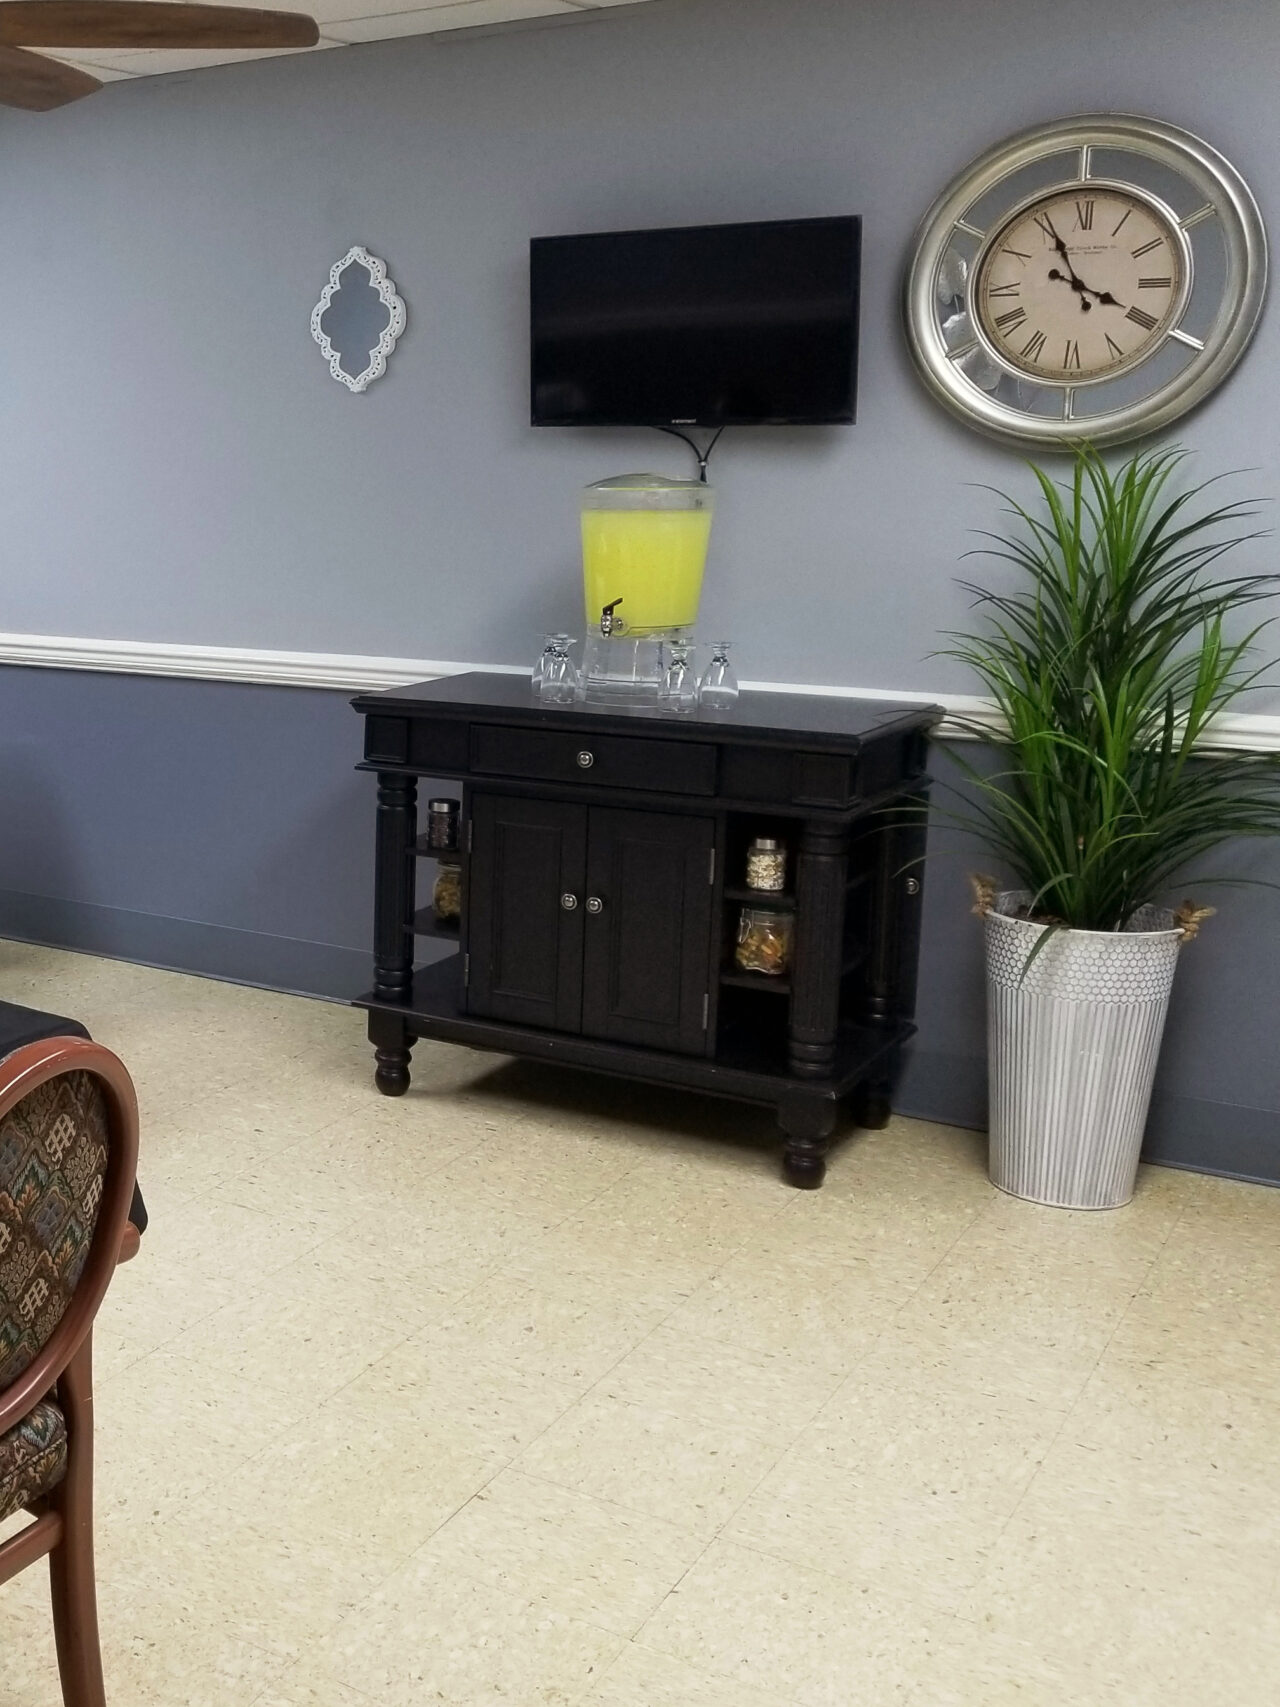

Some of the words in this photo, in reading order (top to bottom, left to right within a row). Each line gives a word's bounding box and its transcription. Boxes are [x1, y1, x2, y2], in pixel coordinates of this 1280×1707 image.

[1072, 200, 1095, 232] XII
[1001, 241, 1032, 267] X
[1131, 237, 1165, 259] II
[989, 282, 1021, 298] IX
[1138, 277, 1171, 289] III
[995, 306, 1028, 338] VIII
[1020, 330, 1048, 363] VII
[1063, 339, 1081, 370] VI
[1104, 332, 1124, 360] V
